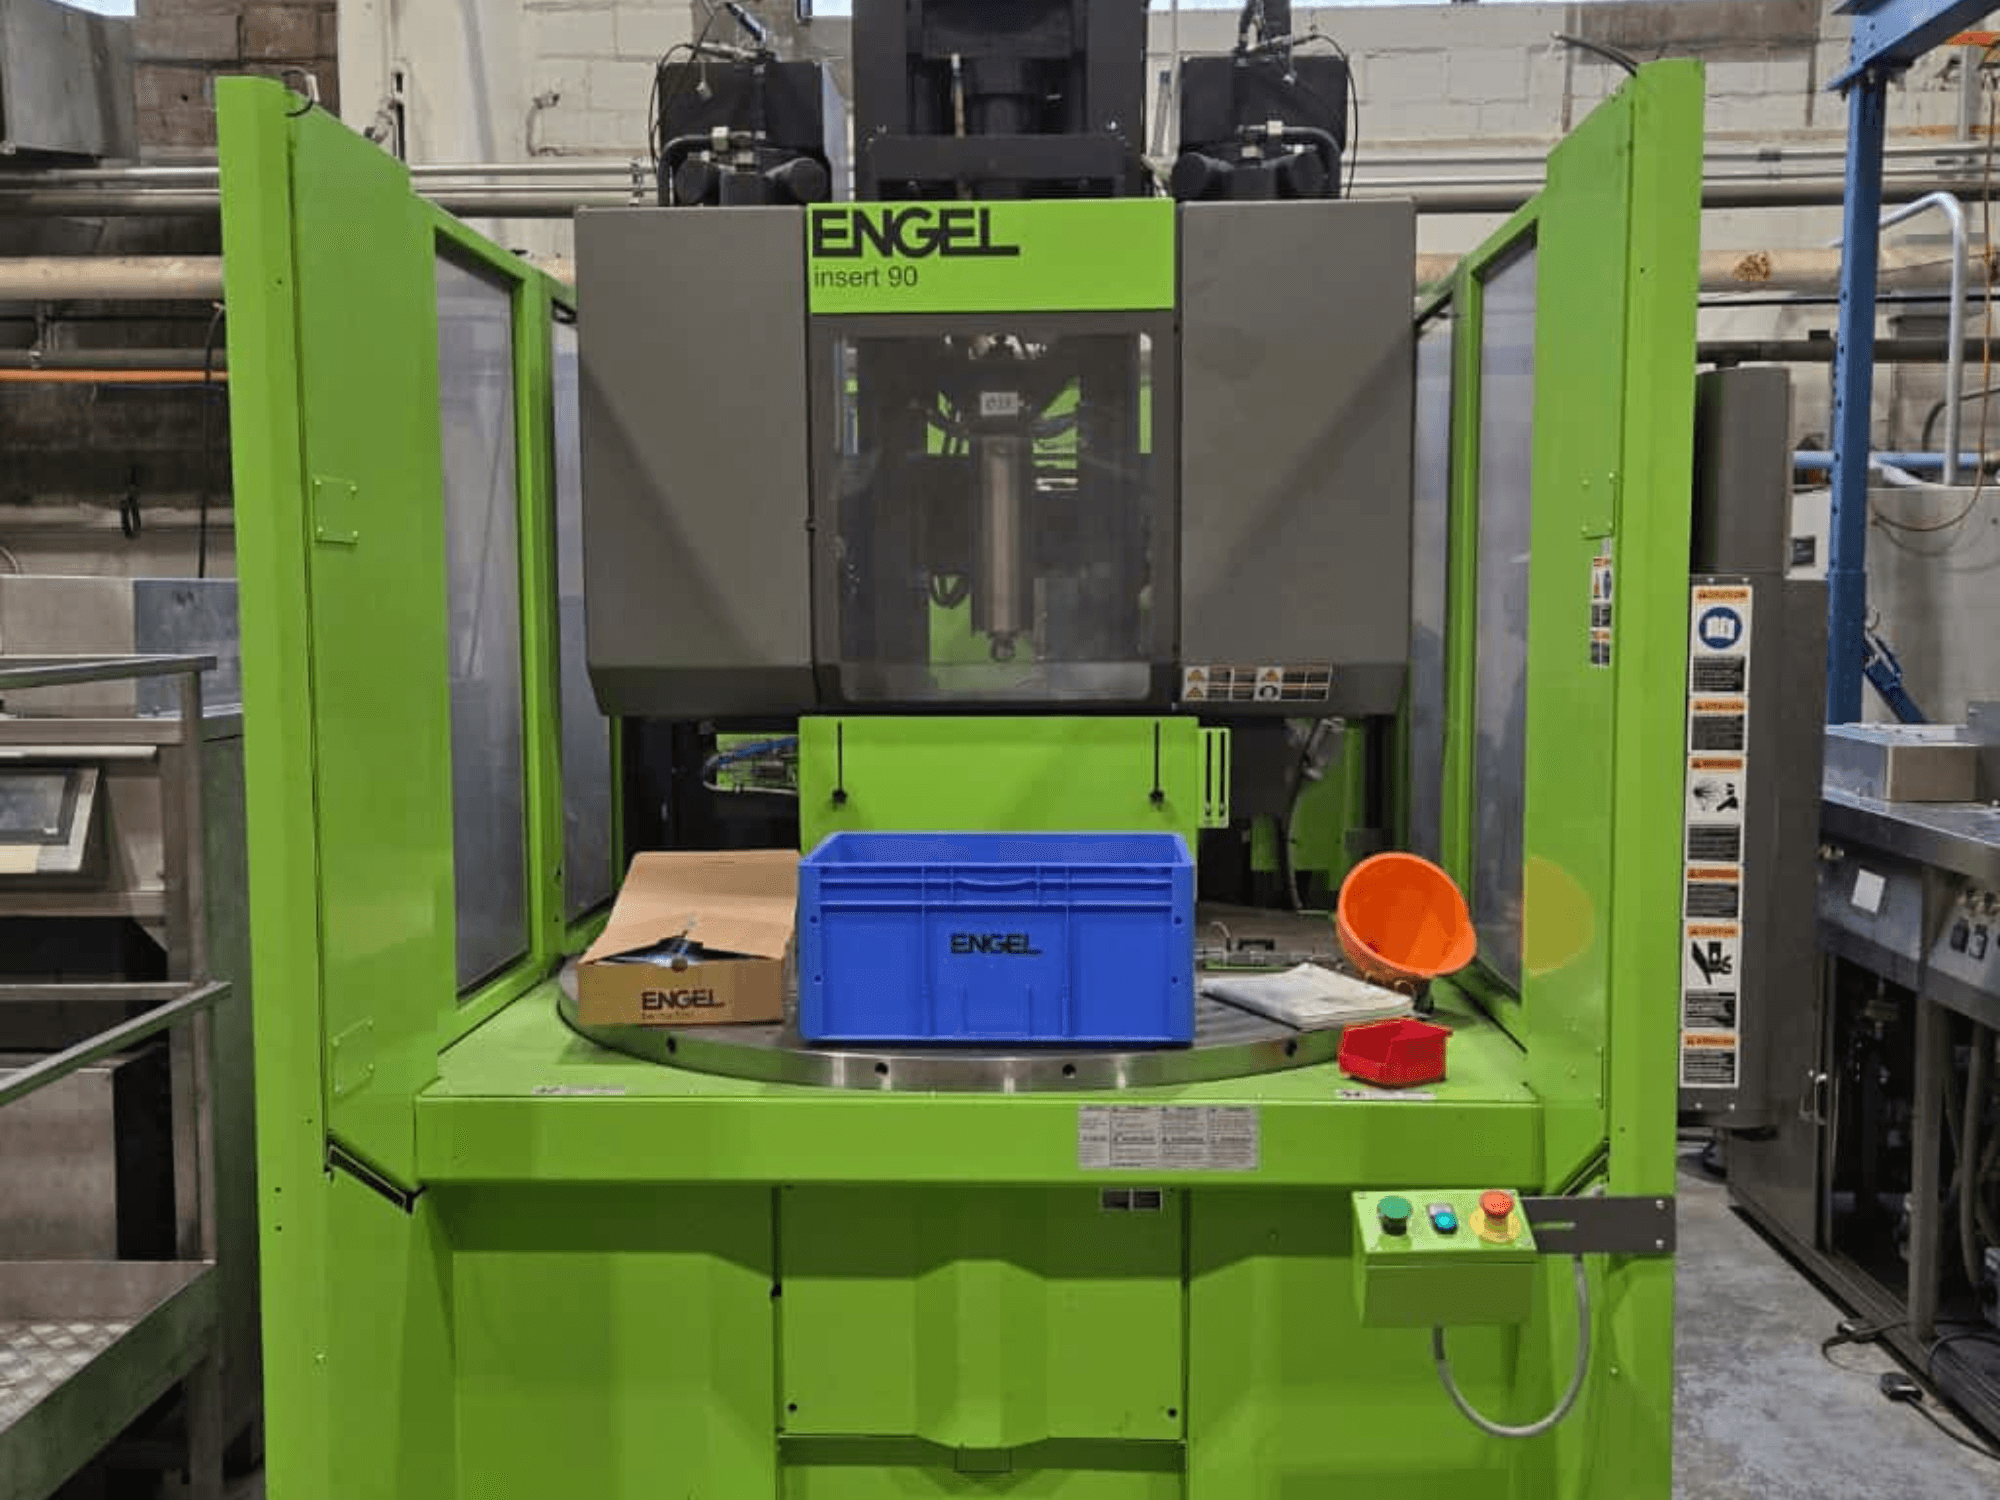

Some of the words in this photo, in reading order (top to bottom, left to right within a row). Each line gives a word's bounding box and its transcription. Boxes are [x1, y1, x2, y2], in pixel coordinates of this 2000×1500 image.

[812, 207, 1020, 258] ENGEL
[814, 266, 878, 287] insert
[888, 266, 918, 287] 90
[951, 932, 1042, 955] ENGEL
[642, 989, 725, 1011] ENGEL
